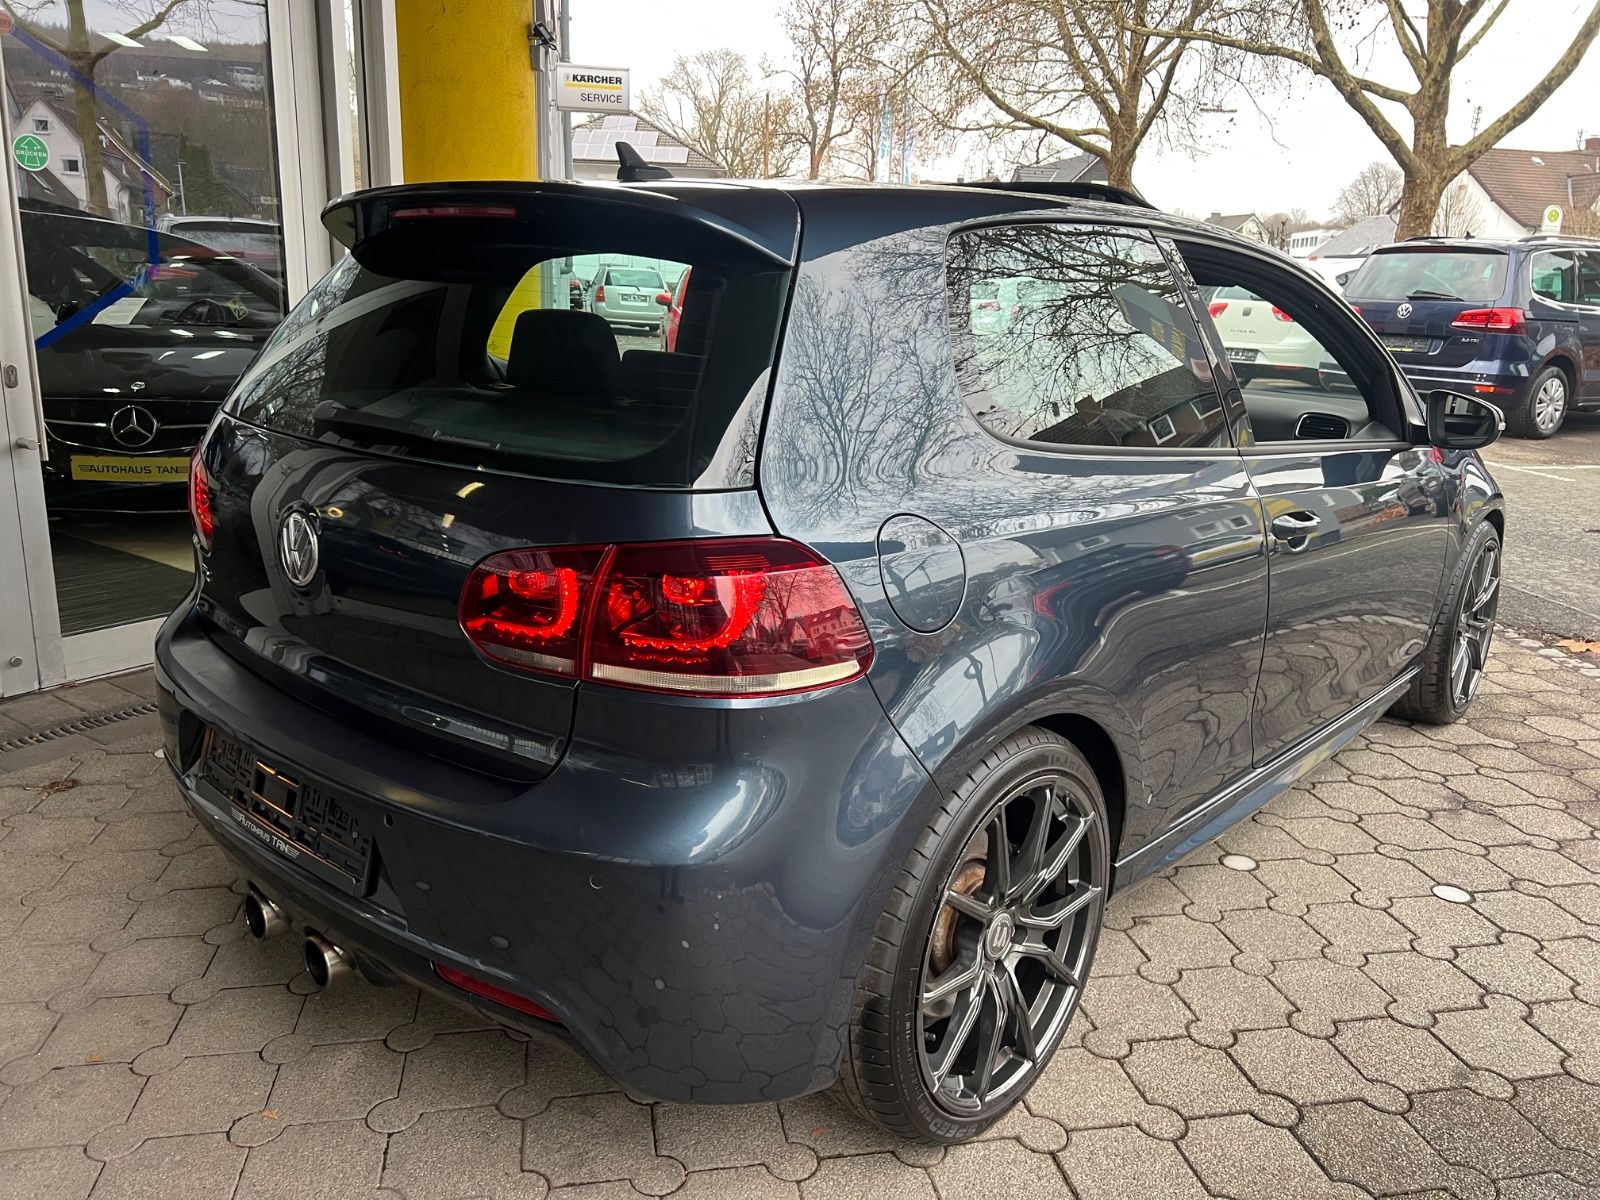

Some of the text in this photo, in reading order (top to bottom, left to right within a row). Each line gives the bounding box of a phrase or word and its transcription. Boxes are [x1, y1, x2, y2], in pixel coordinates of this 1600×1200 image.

[572, 74, 623, 85] KÄRCHER
[580, 92, 623, 104] SERVICE
[90, 464, 178, 474] AUTOHAUS TAN
[239, 813, 289, 854] AUTOHAUS TAN
